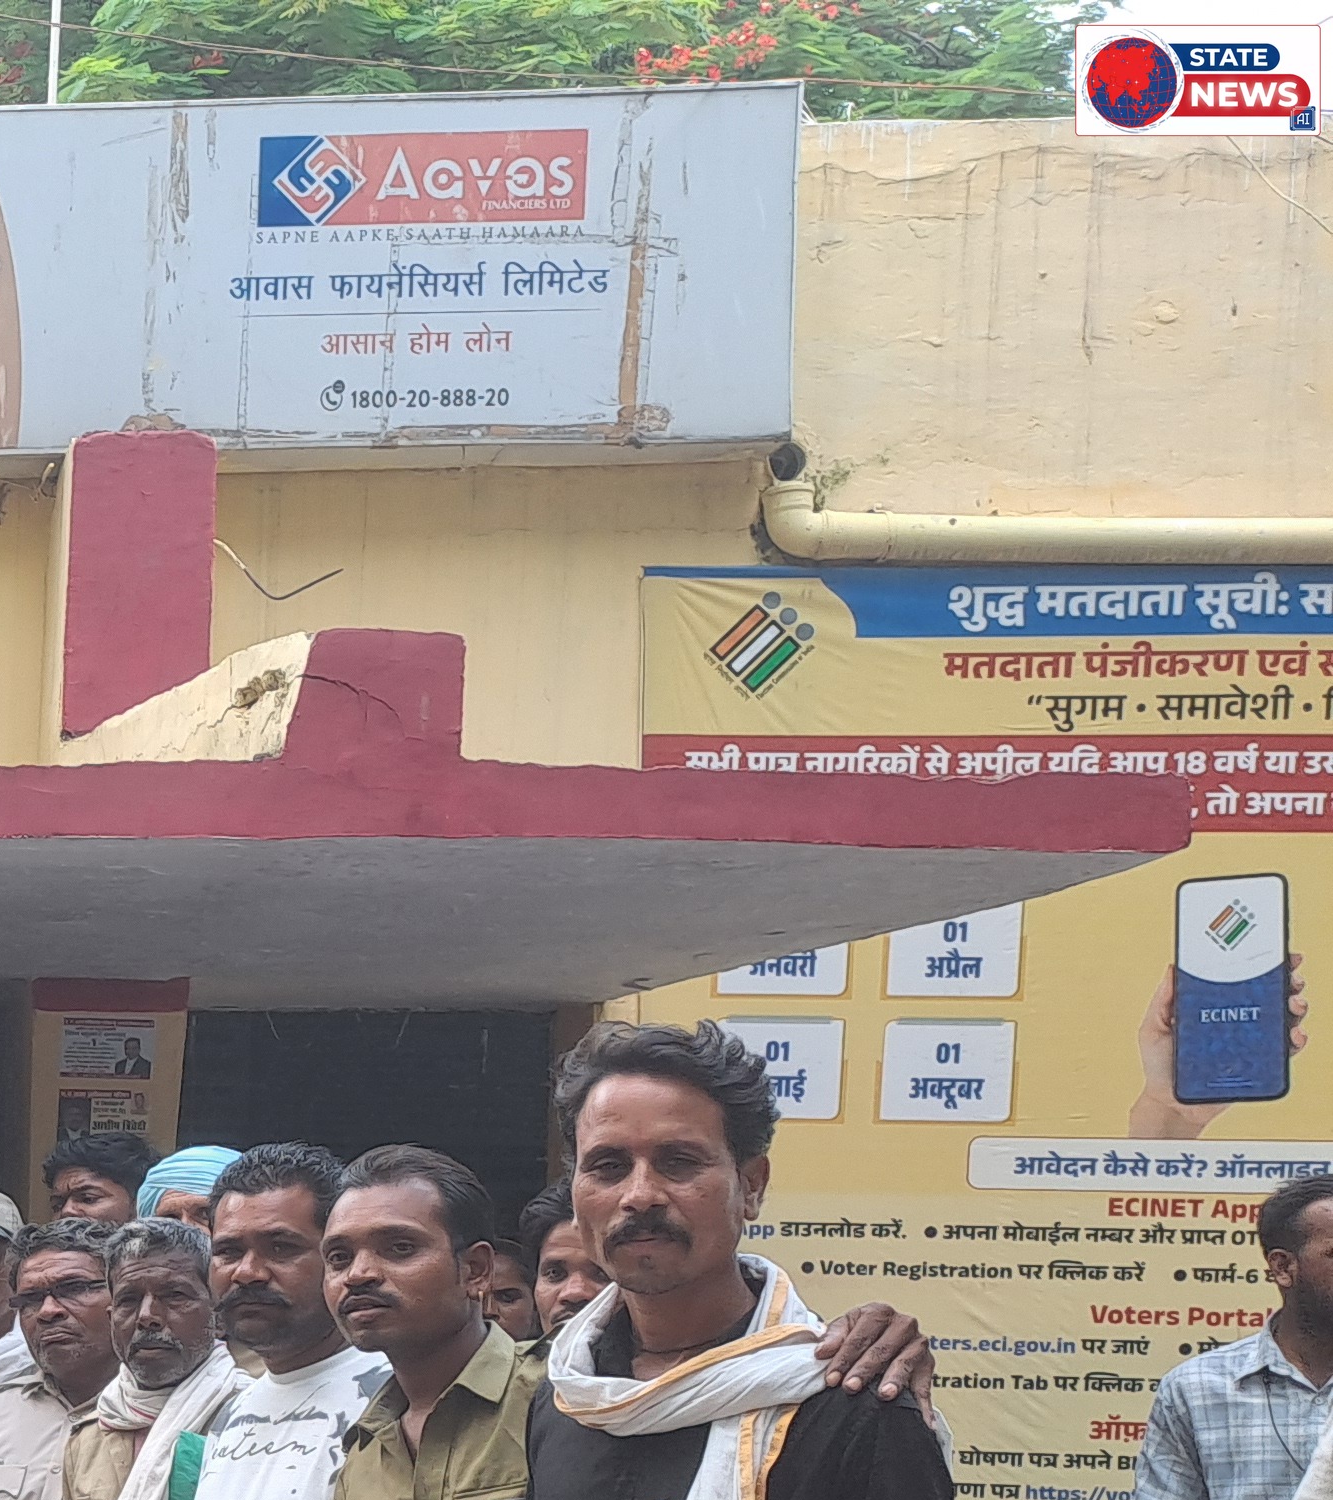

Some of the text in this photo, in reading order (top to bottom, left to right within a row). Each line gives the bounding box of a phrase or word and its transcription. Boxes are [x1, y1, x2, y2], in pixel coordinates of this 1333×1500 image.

[482, 199, 572, 212] FINANCIERS LTD
[256, 230, 320, 245] SAPNE
[406, 227, 471, 242] SAATH
[229, 260, 610, 301] आवास फायनेंसियर्स लिमिटेड
[321, 323, 512, 356] आसान होम लोन
[350, 386, 510, 410] 1800-20-888-20
[947, 585, 1028, 632] शुद्ध
[1035, 584, 1187, 619] मतदाता
[1194, 571, 1290, 630] सूची:
[943, 651, 1076, 681] मतदाता
[1082, 641, 1249, 678] पंजीकरण
[1256, 641, 1310, 677] एवं
[1156, 684, 1294, 720] समावेशी
[804, 745, 921, 774] नागरिकों
[924, 745, 951, 775] से
[956, 745, 1042, 775] अपील
[1047, 745, 1102, 774] यदि
[1106, 752, 1167, 774] आप
[1173, 752, 1207, 774] 18
[1214, 743, 1259, 774] वर्ष
[1264, 752, 1299, 774] या
[1205, 784, 1327, 816] तो अपना
[943, 921, 968, 943] 01
[925, 948, 983, 979] अप्रैल
[1200, 1006, 1261, 1023] ECINET
[765, 1041, 790, 1062] 01
[936, 1043, 961, 1064] 01
[909, 1078, 985, 1109] अक्टूबर
[1013, 1151, 1097, 1177] आवेदन
[1103, 1150, 1149, 1177] कैसे
[1155, 1153, 1208, 1178] करें?
[1108, 1198, 1204, 1218] ECINET
[780, 1218, 867, 1238] डाउनलोड
[943, 1225, 997, 1240] अपना
[1085, 1228, 1134, 1245] नम्बर
[1139, 1222, 1176, 1244] और
[1181, 1230, 1226, 1247] प्राप्त
[820, 1260, 1146, 1283] Voter Registration पर क्लिक करें
[1090, 1305, 1180, 1325] Voters
[930, 1336, 1150, 1356] ters.eci.gov.in पर जाएं
[932, 1372, 1144, 1393] tration Tab पर क्लिक
[959, 1446, 1023, 1467] घोषणा
[1028, 1454, 1059, 1468] पत्र
[1063, 1449, 1113, 1469] अपने
[991, 1486, 1021, 1500] पत्र
